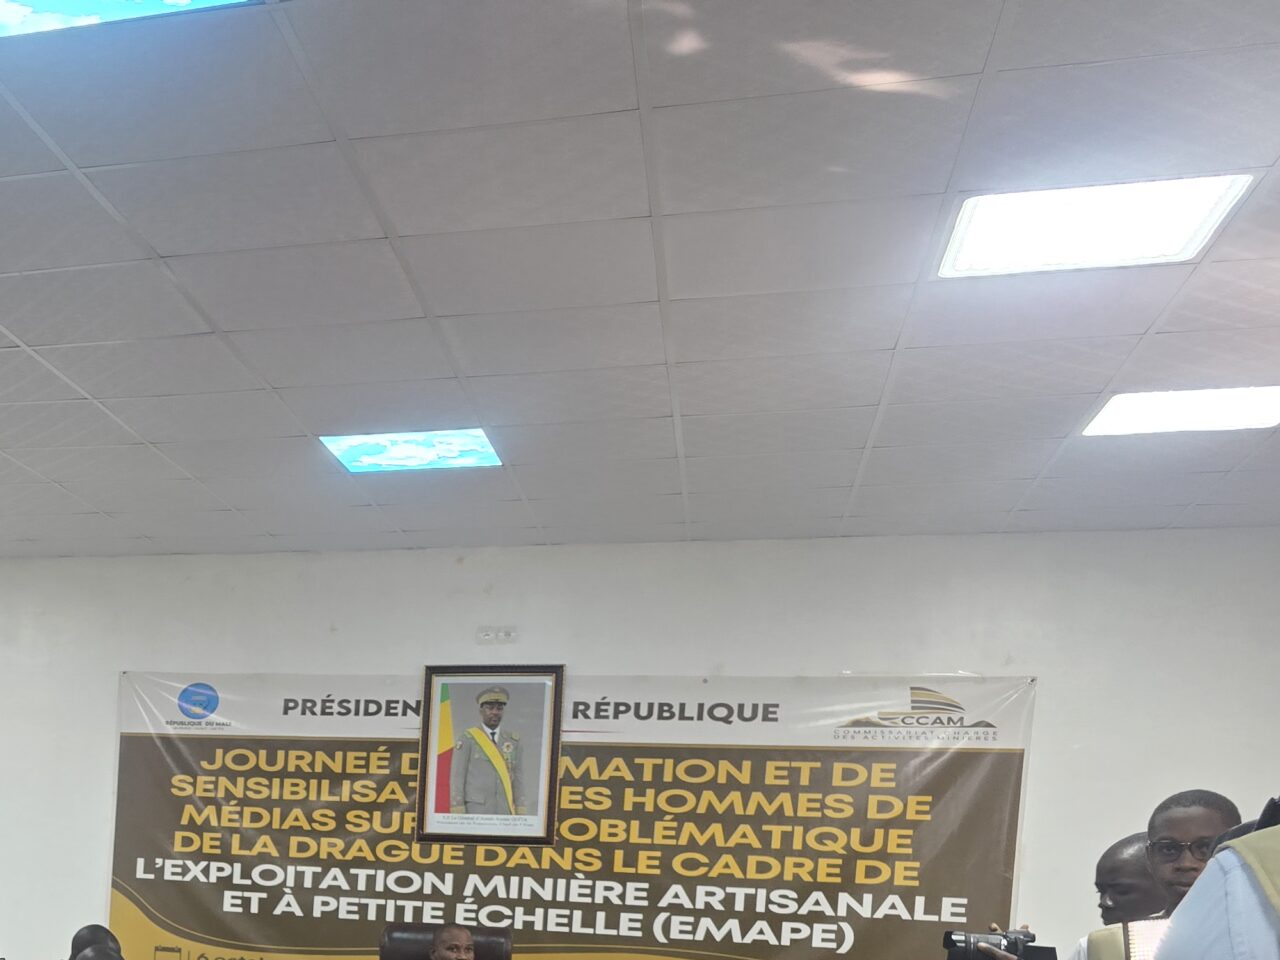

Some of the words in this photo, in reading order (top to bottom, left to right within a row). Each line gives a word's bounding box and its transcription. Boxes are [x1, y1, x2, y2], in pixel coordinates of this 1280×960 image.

[572, 696, 780, 725] RÉPUBLIQUE
[901, 716, 965, 726] CCAM
[200, 746, 391, 775] JOURNEÉ
[765, 760, 821, 786] ET
[831, 761, 897, 788] DE
[180, 800, 337, 832] MÉDIAS
[556, 815, 914, 854] OBLÉMATIQUE
[623, 787, 855, 819] HOMMES
[867, 794, 932, 821] DE
[173, 831, 222, 854] DE
[231, 834, 279, 857] LA
[288, 836, 465, 866] DRAGUE
[475, 845, 603, 872] DANS
[613, 850, 662, 875] LE
[671, 853, 842, 883] CADRE
[854, 859, 920, 887] DE
[136, 857, 454, 896] L'EXPLOITATION
[463, 873, 650, 907] MINIÈRE
[657, 884, 968, 923] ARTISANALE
[222, 890, 267, 914] ET
[273, 888, 304, 917] À
[312, 895, 445, 925] PETITE
[455, 898, 644, 937] ÉCHELLE
[652, 912, 855, 954] (EMAPE)
